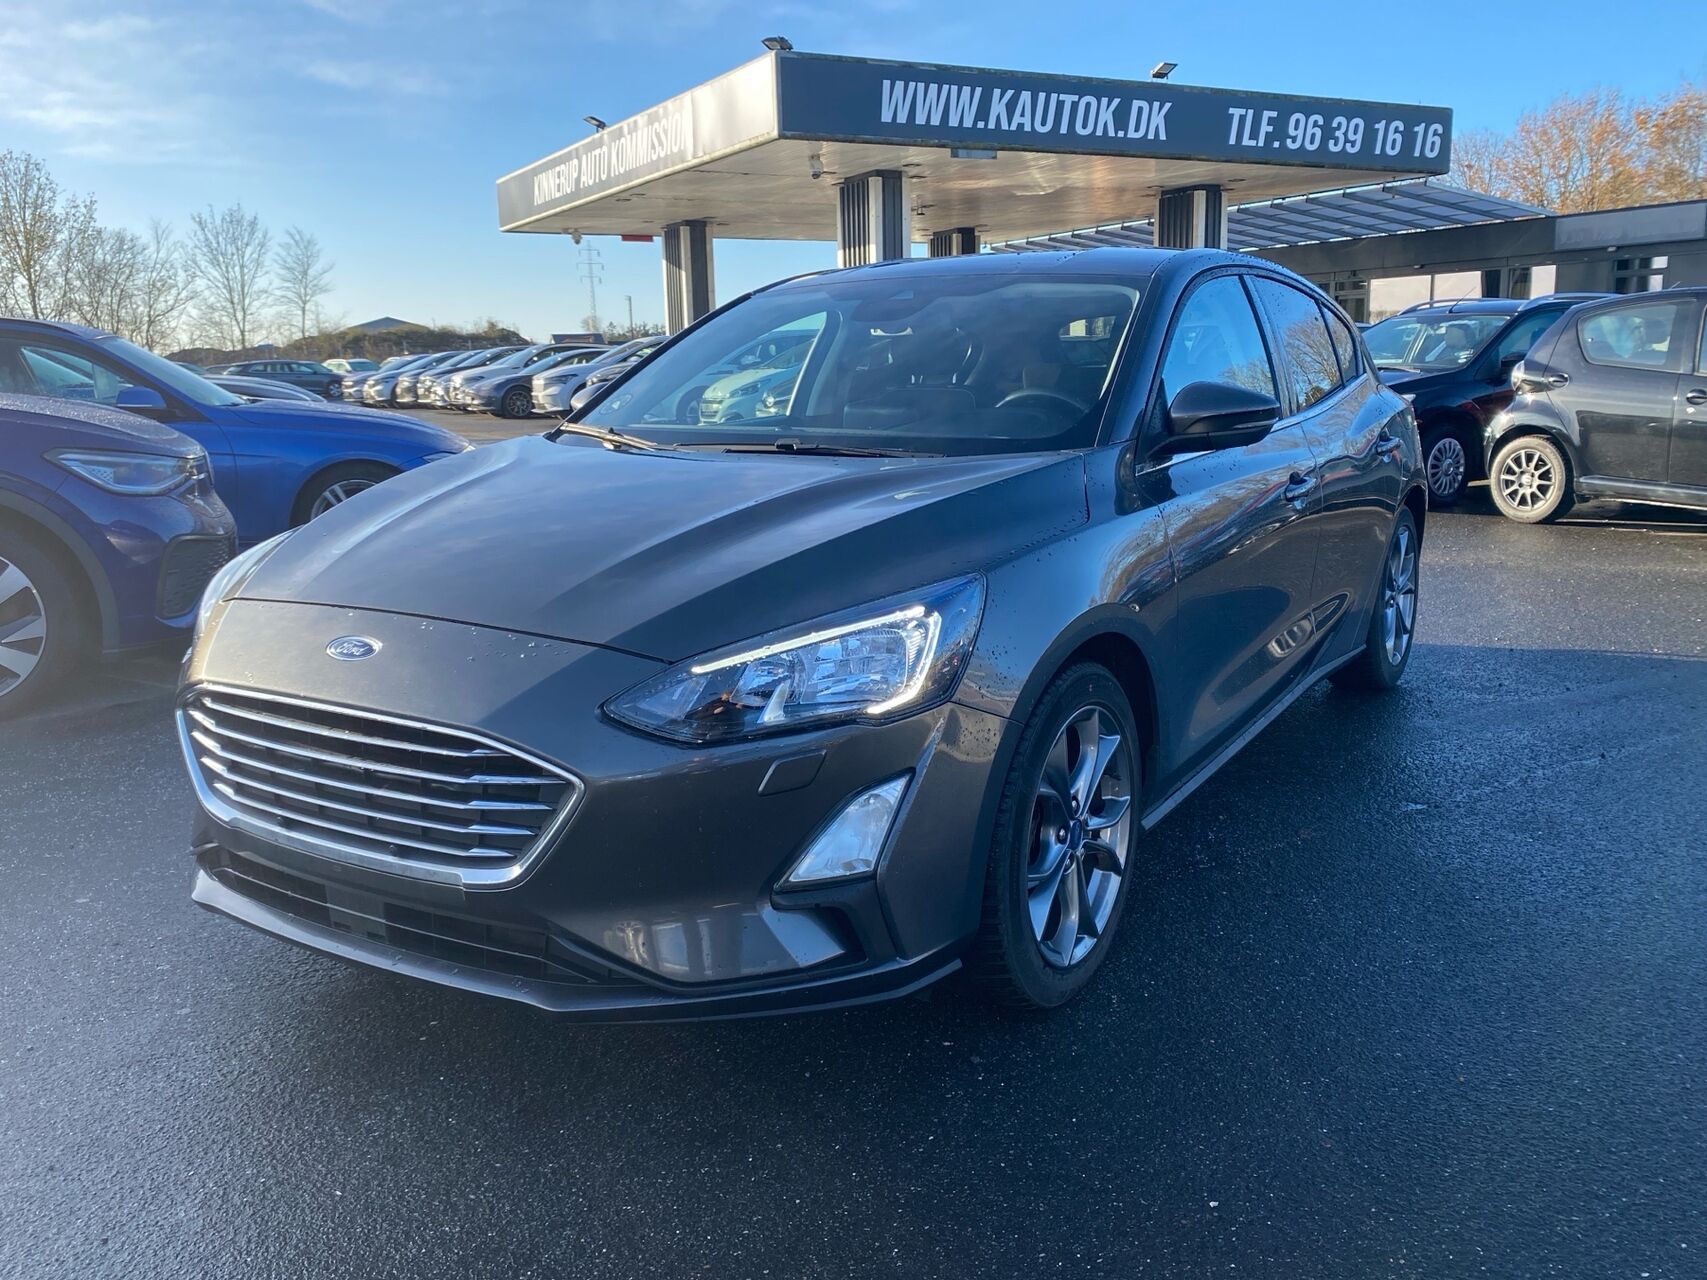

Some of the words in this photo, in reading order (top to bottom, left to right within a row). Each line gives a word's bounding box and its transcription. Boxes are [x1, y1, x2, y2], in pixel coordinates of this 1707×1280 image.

[881, 79, 1172, 140] WWW.KAUTOK.DK
[1228, 107, 1280, 148] TLF.
[1286, 112, 1324, 151] 96
[1328, 116, 1365, 153] 39
[1374, 119, 1404, 156] 16
[1413, 122, 1443, 158] 16
[533, 158, 579, 206] KINNERUP
[580, 145, 608, 189] AUTO
[611, 110, 693, 177] KOMMISSION
[335, 640, 370, 656] Ford
